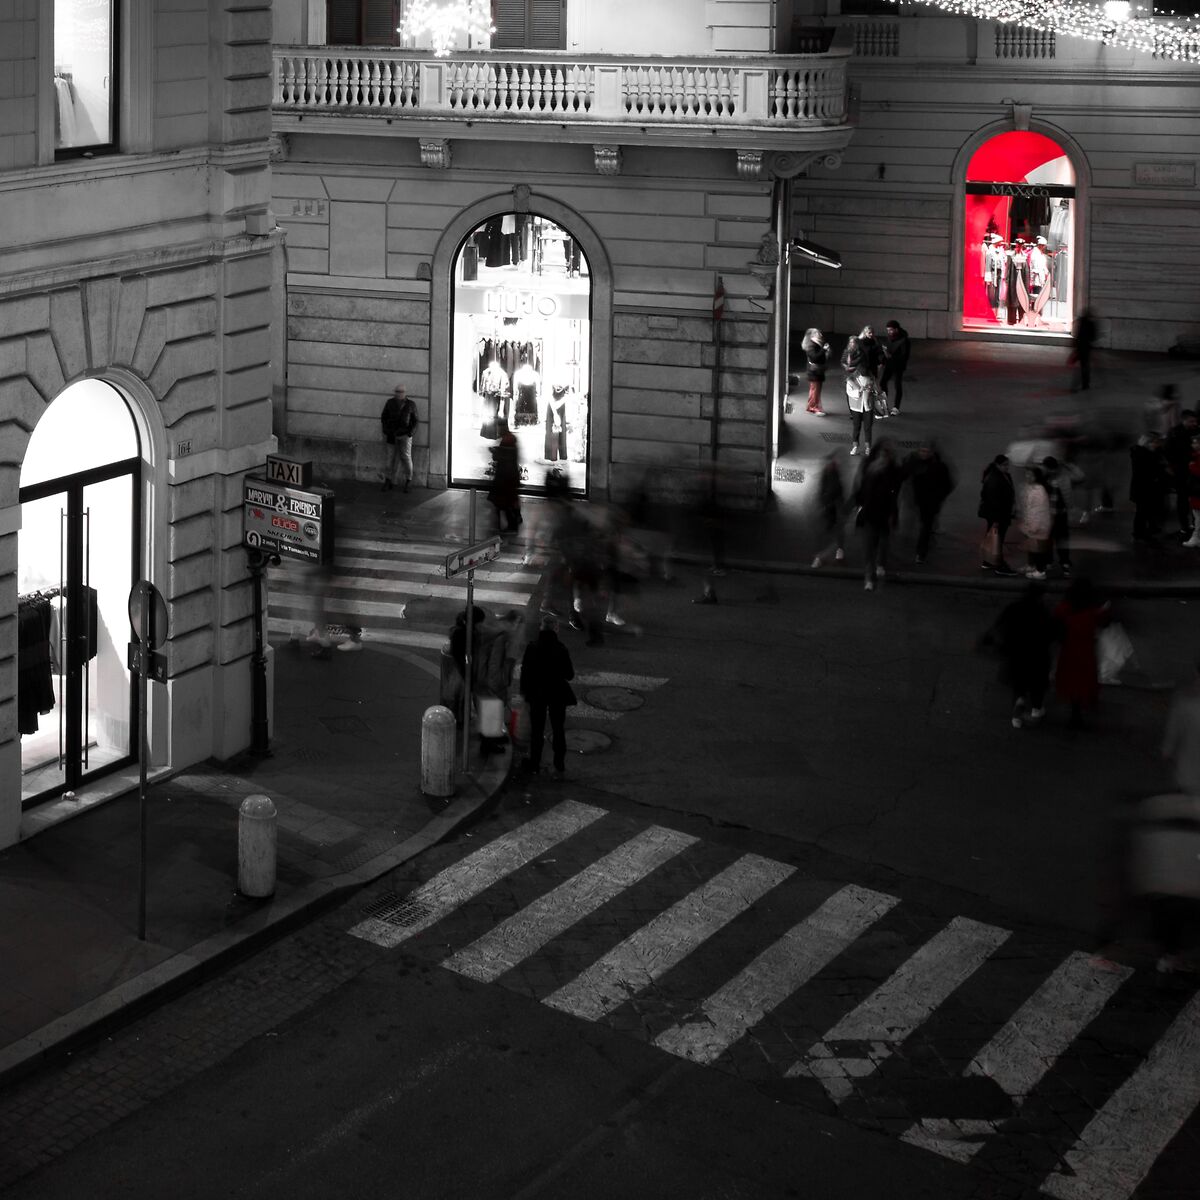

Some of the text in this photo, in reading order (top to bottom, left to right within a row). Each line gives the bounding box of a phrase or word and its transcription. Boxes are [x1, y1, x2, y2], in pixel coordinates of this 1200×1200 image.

[269, 460, 300, 483] TAXI
[275, 494, 289, 515] &
[290, 499, 317, 516] FRIENDS
